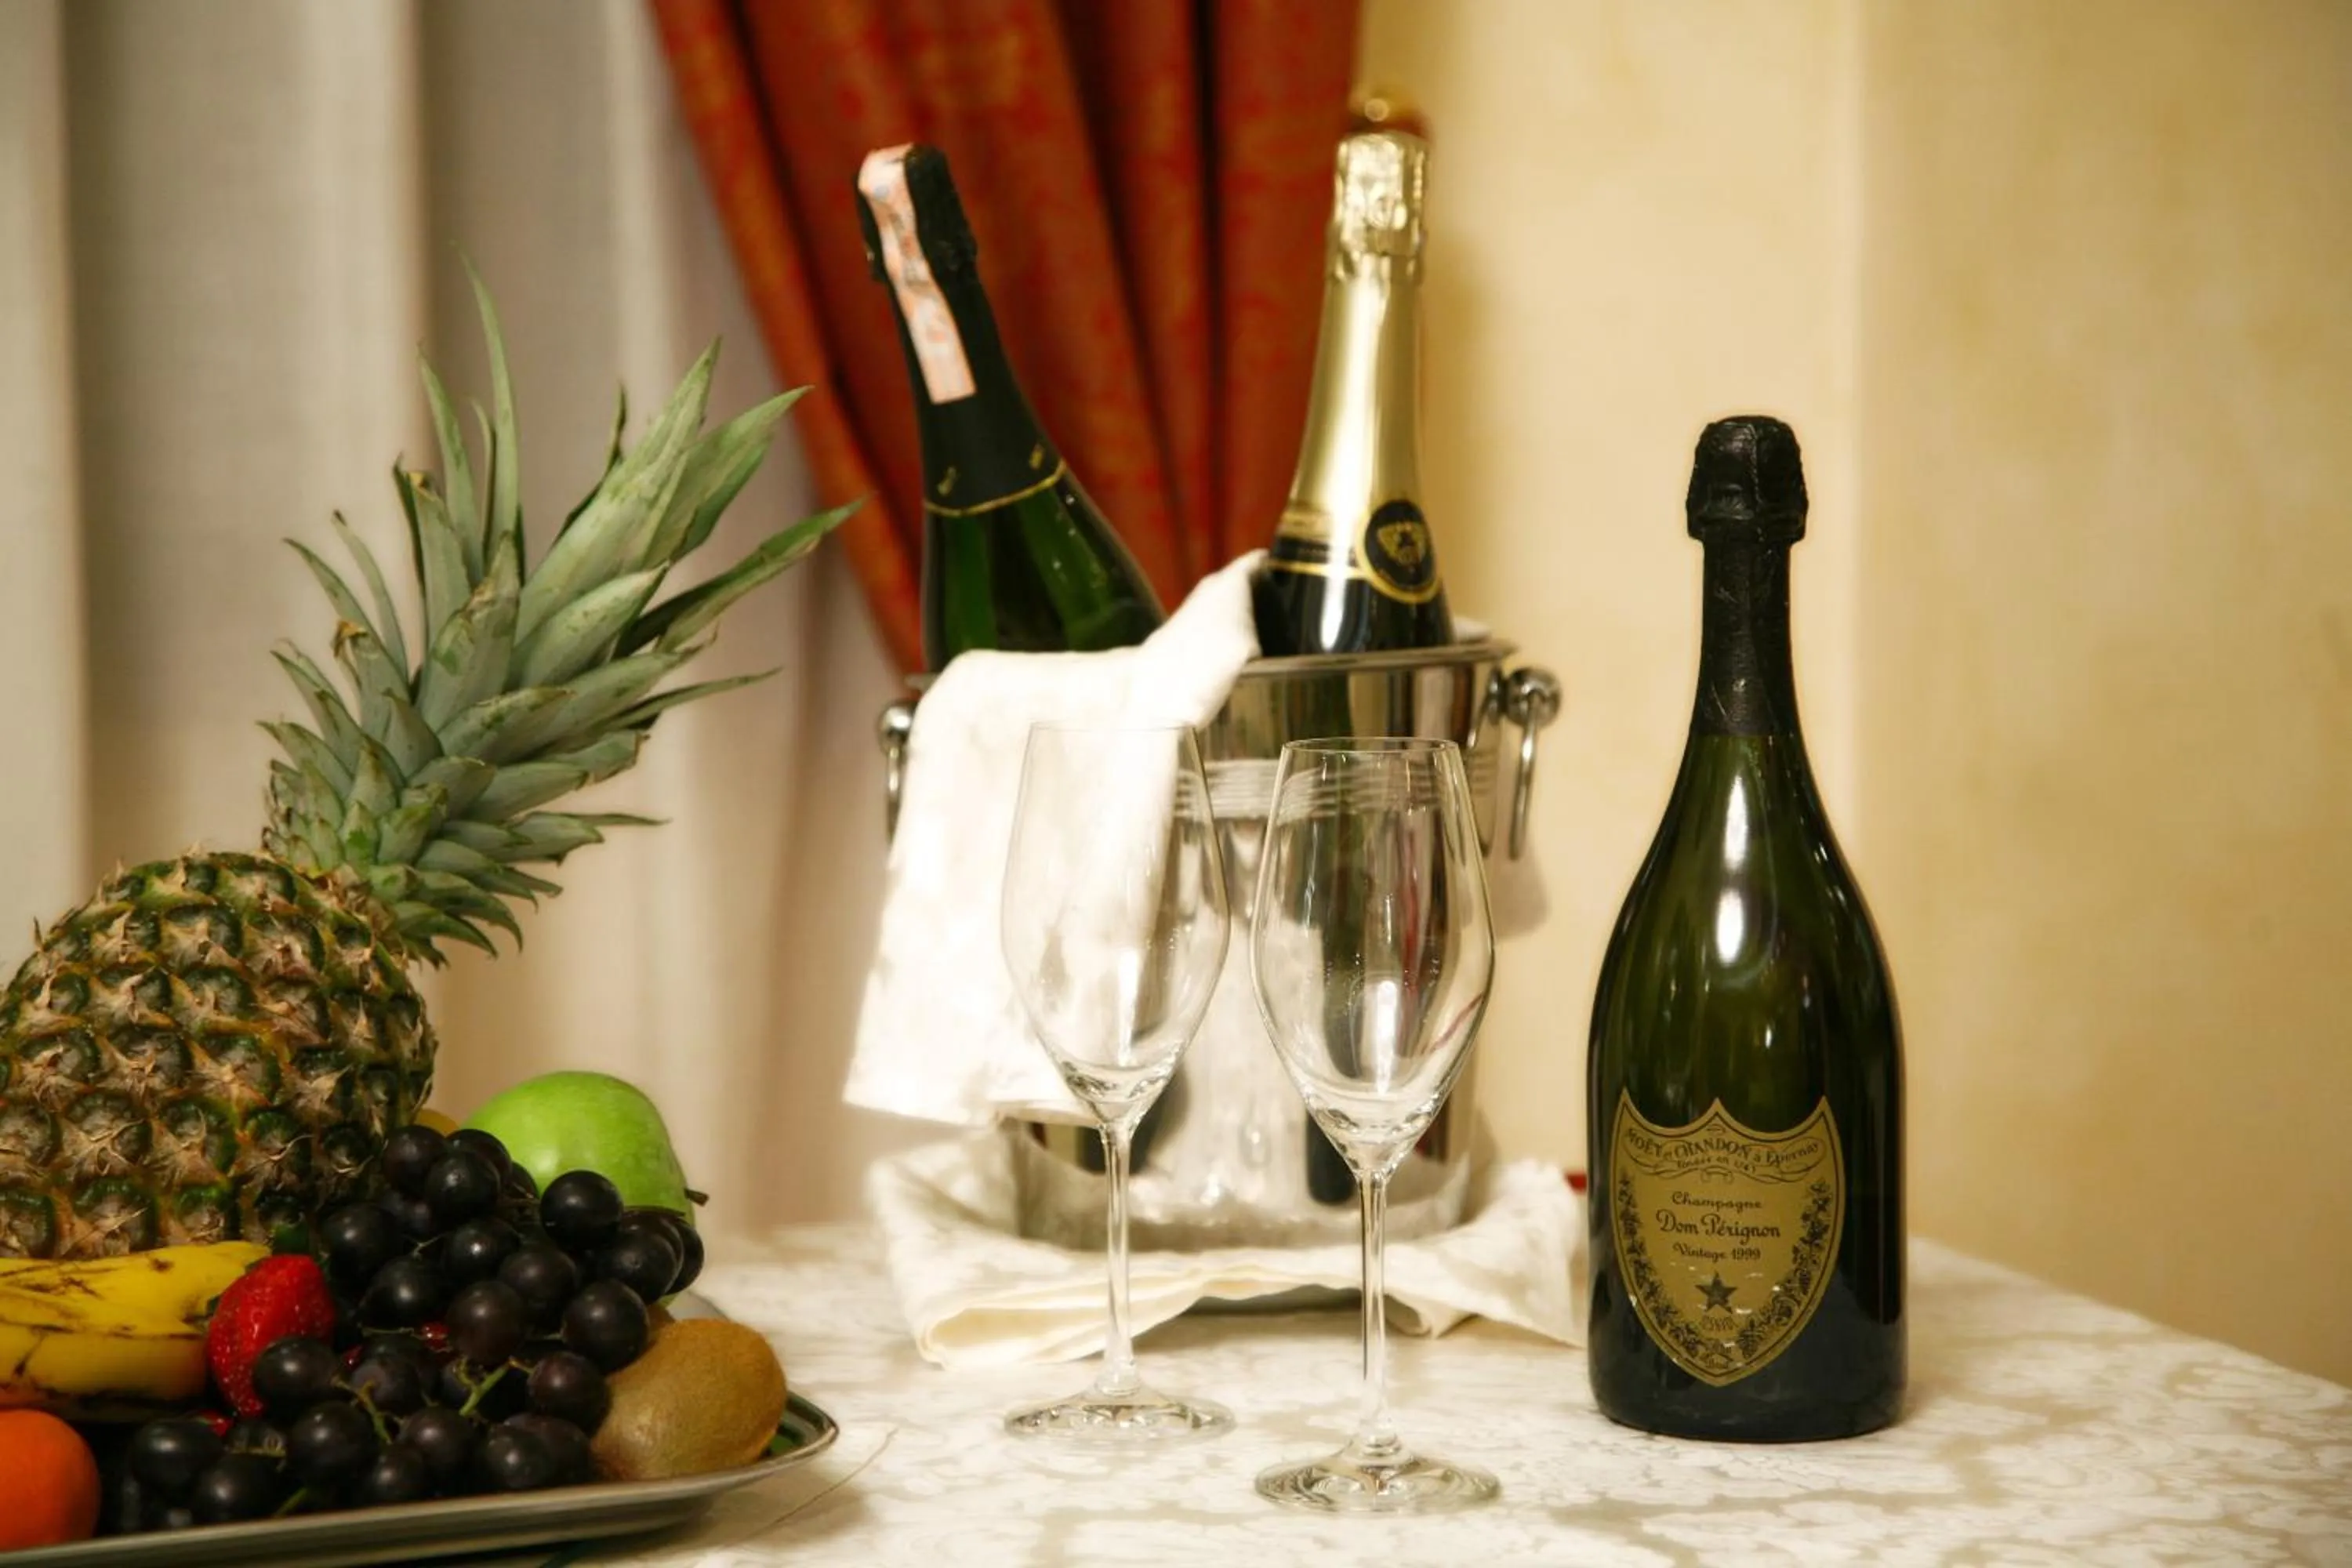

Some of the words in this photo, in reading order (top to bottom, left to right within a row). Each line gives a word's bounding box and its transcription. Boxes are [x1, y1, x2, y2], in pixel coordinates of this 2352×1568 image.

[1675, 1138, 1748, 1160] CHANDON
[1671, 1191, 1762, 1213] Champagne
[1655, 1209, 1699, 1234] Dom
[1700, 1213, 1780, 1245] Pérignon
[1672, 1242, 1727, 1262] Vintage
